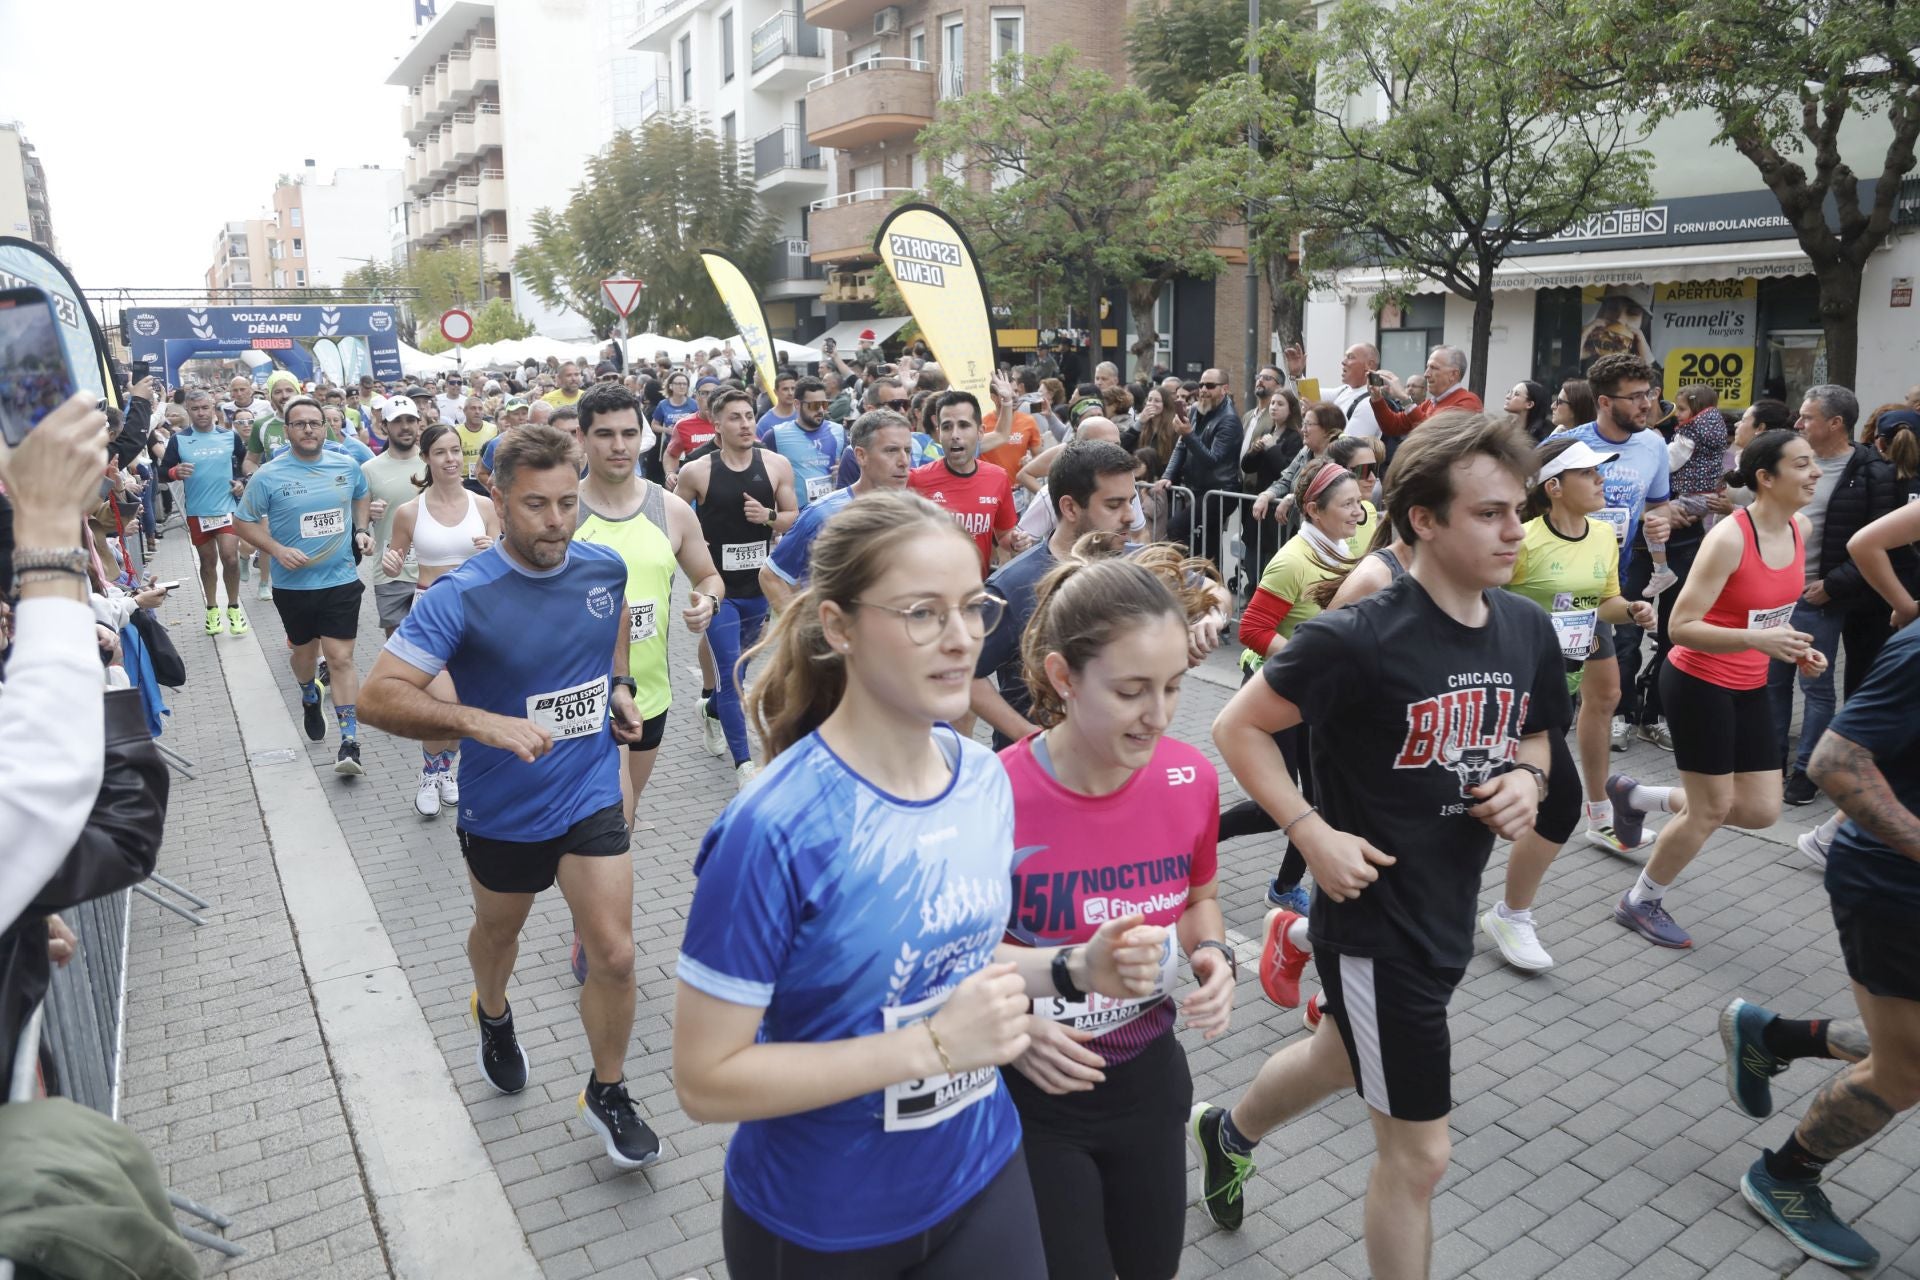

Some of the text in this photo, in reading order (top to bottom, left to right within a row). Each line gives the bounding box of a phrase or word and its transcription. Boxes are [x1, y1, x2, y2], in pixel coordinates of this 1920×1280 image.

[1737, 264, 1796, 277] PuraMasa
[1491, 278, 1525, 288] BRADOR
[1593, 272, 1643, 284] CAFETERÍA
[1667, 287, 1743, 300] APERTURA
[232, 313, 301, 322] VOLTA A PEU
[1664, 310, 1744, 328] Fanneli's
[248, 322, 288, 334] DÉNIA
[1709, 327, 1744, 337] burgers
[1680, 353, 1743, 377] 200
[313, 518, 334, 528] 3490
[736, 551, 757, 561] 3553
[1569, 632, 1582, 647] 77
[1448, 672, 1513, 688] CHICAGO
[560, 693, 578, 704] SOM
[580, 683, 604, 697] ESPORT
[554, 698, 596, 722] 3602
[923, 929, 994, 969] CIRCUIT
[1073, 1003, 1140, 1029] BALEARIA
[935, 1064, 995, 1106] BALEARIA
